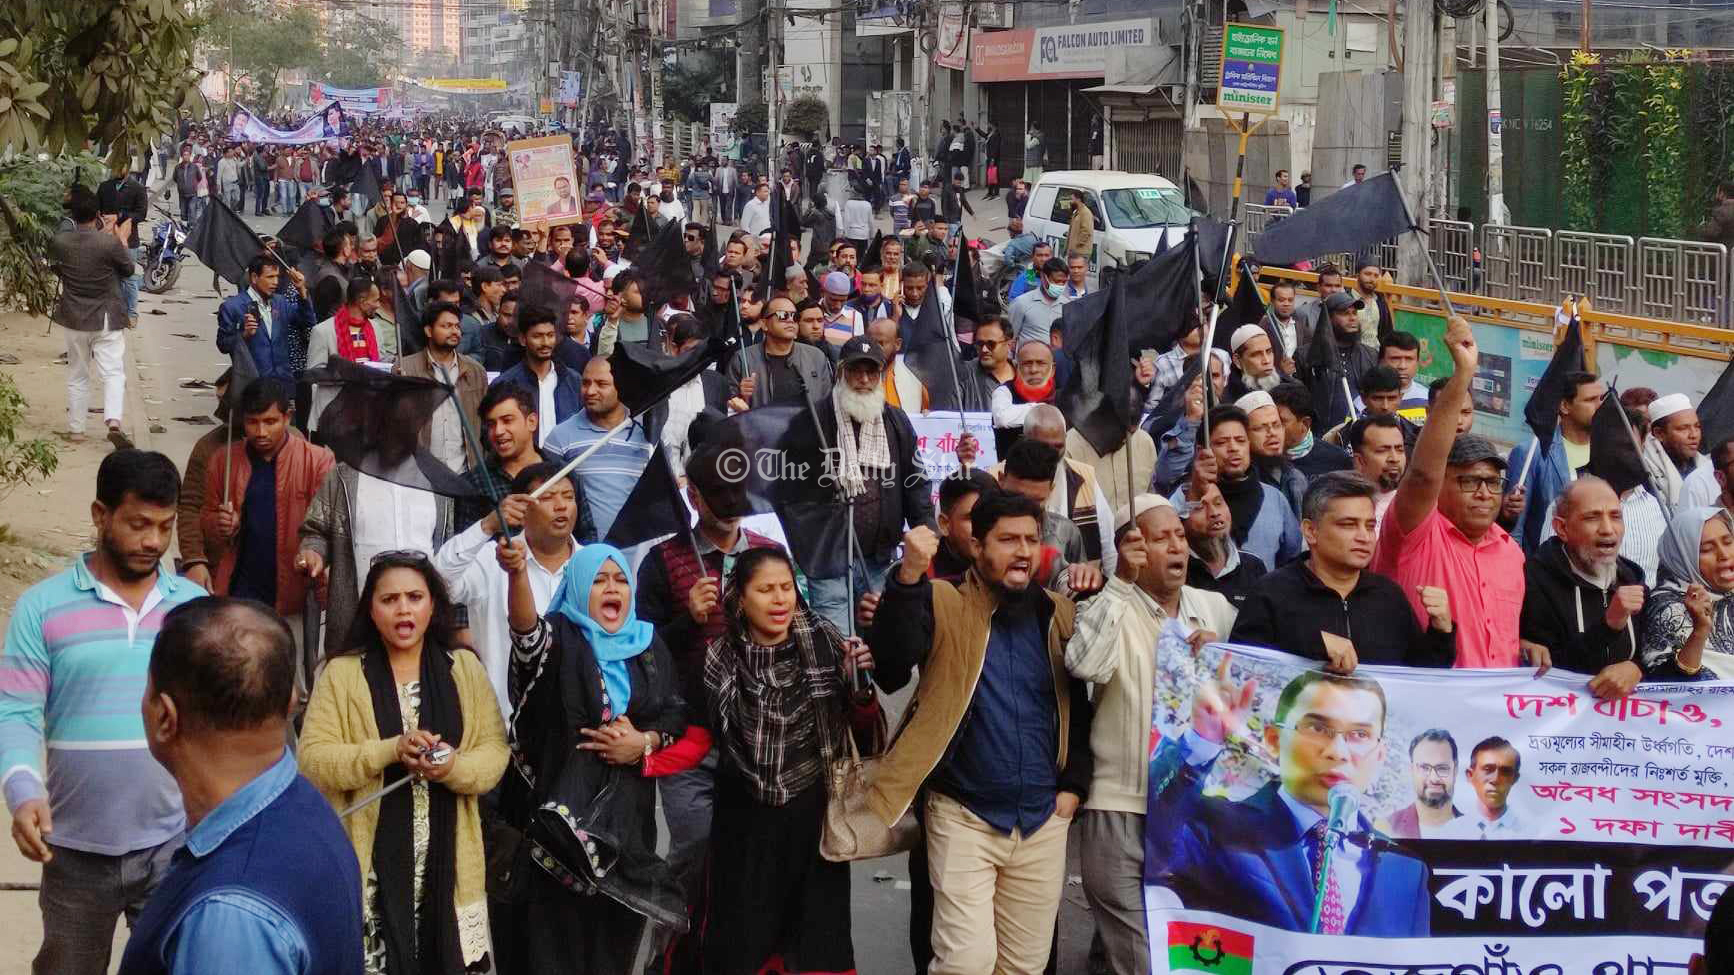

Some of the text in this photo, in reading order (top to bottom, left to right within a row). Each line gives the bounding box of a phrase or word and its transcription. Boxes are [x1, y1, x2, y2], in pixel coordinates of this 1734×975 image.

[1058, 28, 1144, 49] FALCON AUTO LIMITED
[1223, 90, 1273, 105] minister
[1504, 692, 1579, 718] দেশ
[1528, 735, 1585, 753] দ্রব্যমূল্যের
[1589, 732, 1635, 751] সীমাহীন
[1539, 762, 1568, 776] সকল
[1571, 758, 1640, 777] রাজবন্দীদের
[1645, 761, 1690, 780] নিঃশর্ত
[1530, 781, 1734, 811] অবৈধ সংসদ
[1590, 818, 1664, 838] দফা
[1432, 863, 1613, 927] কালো
